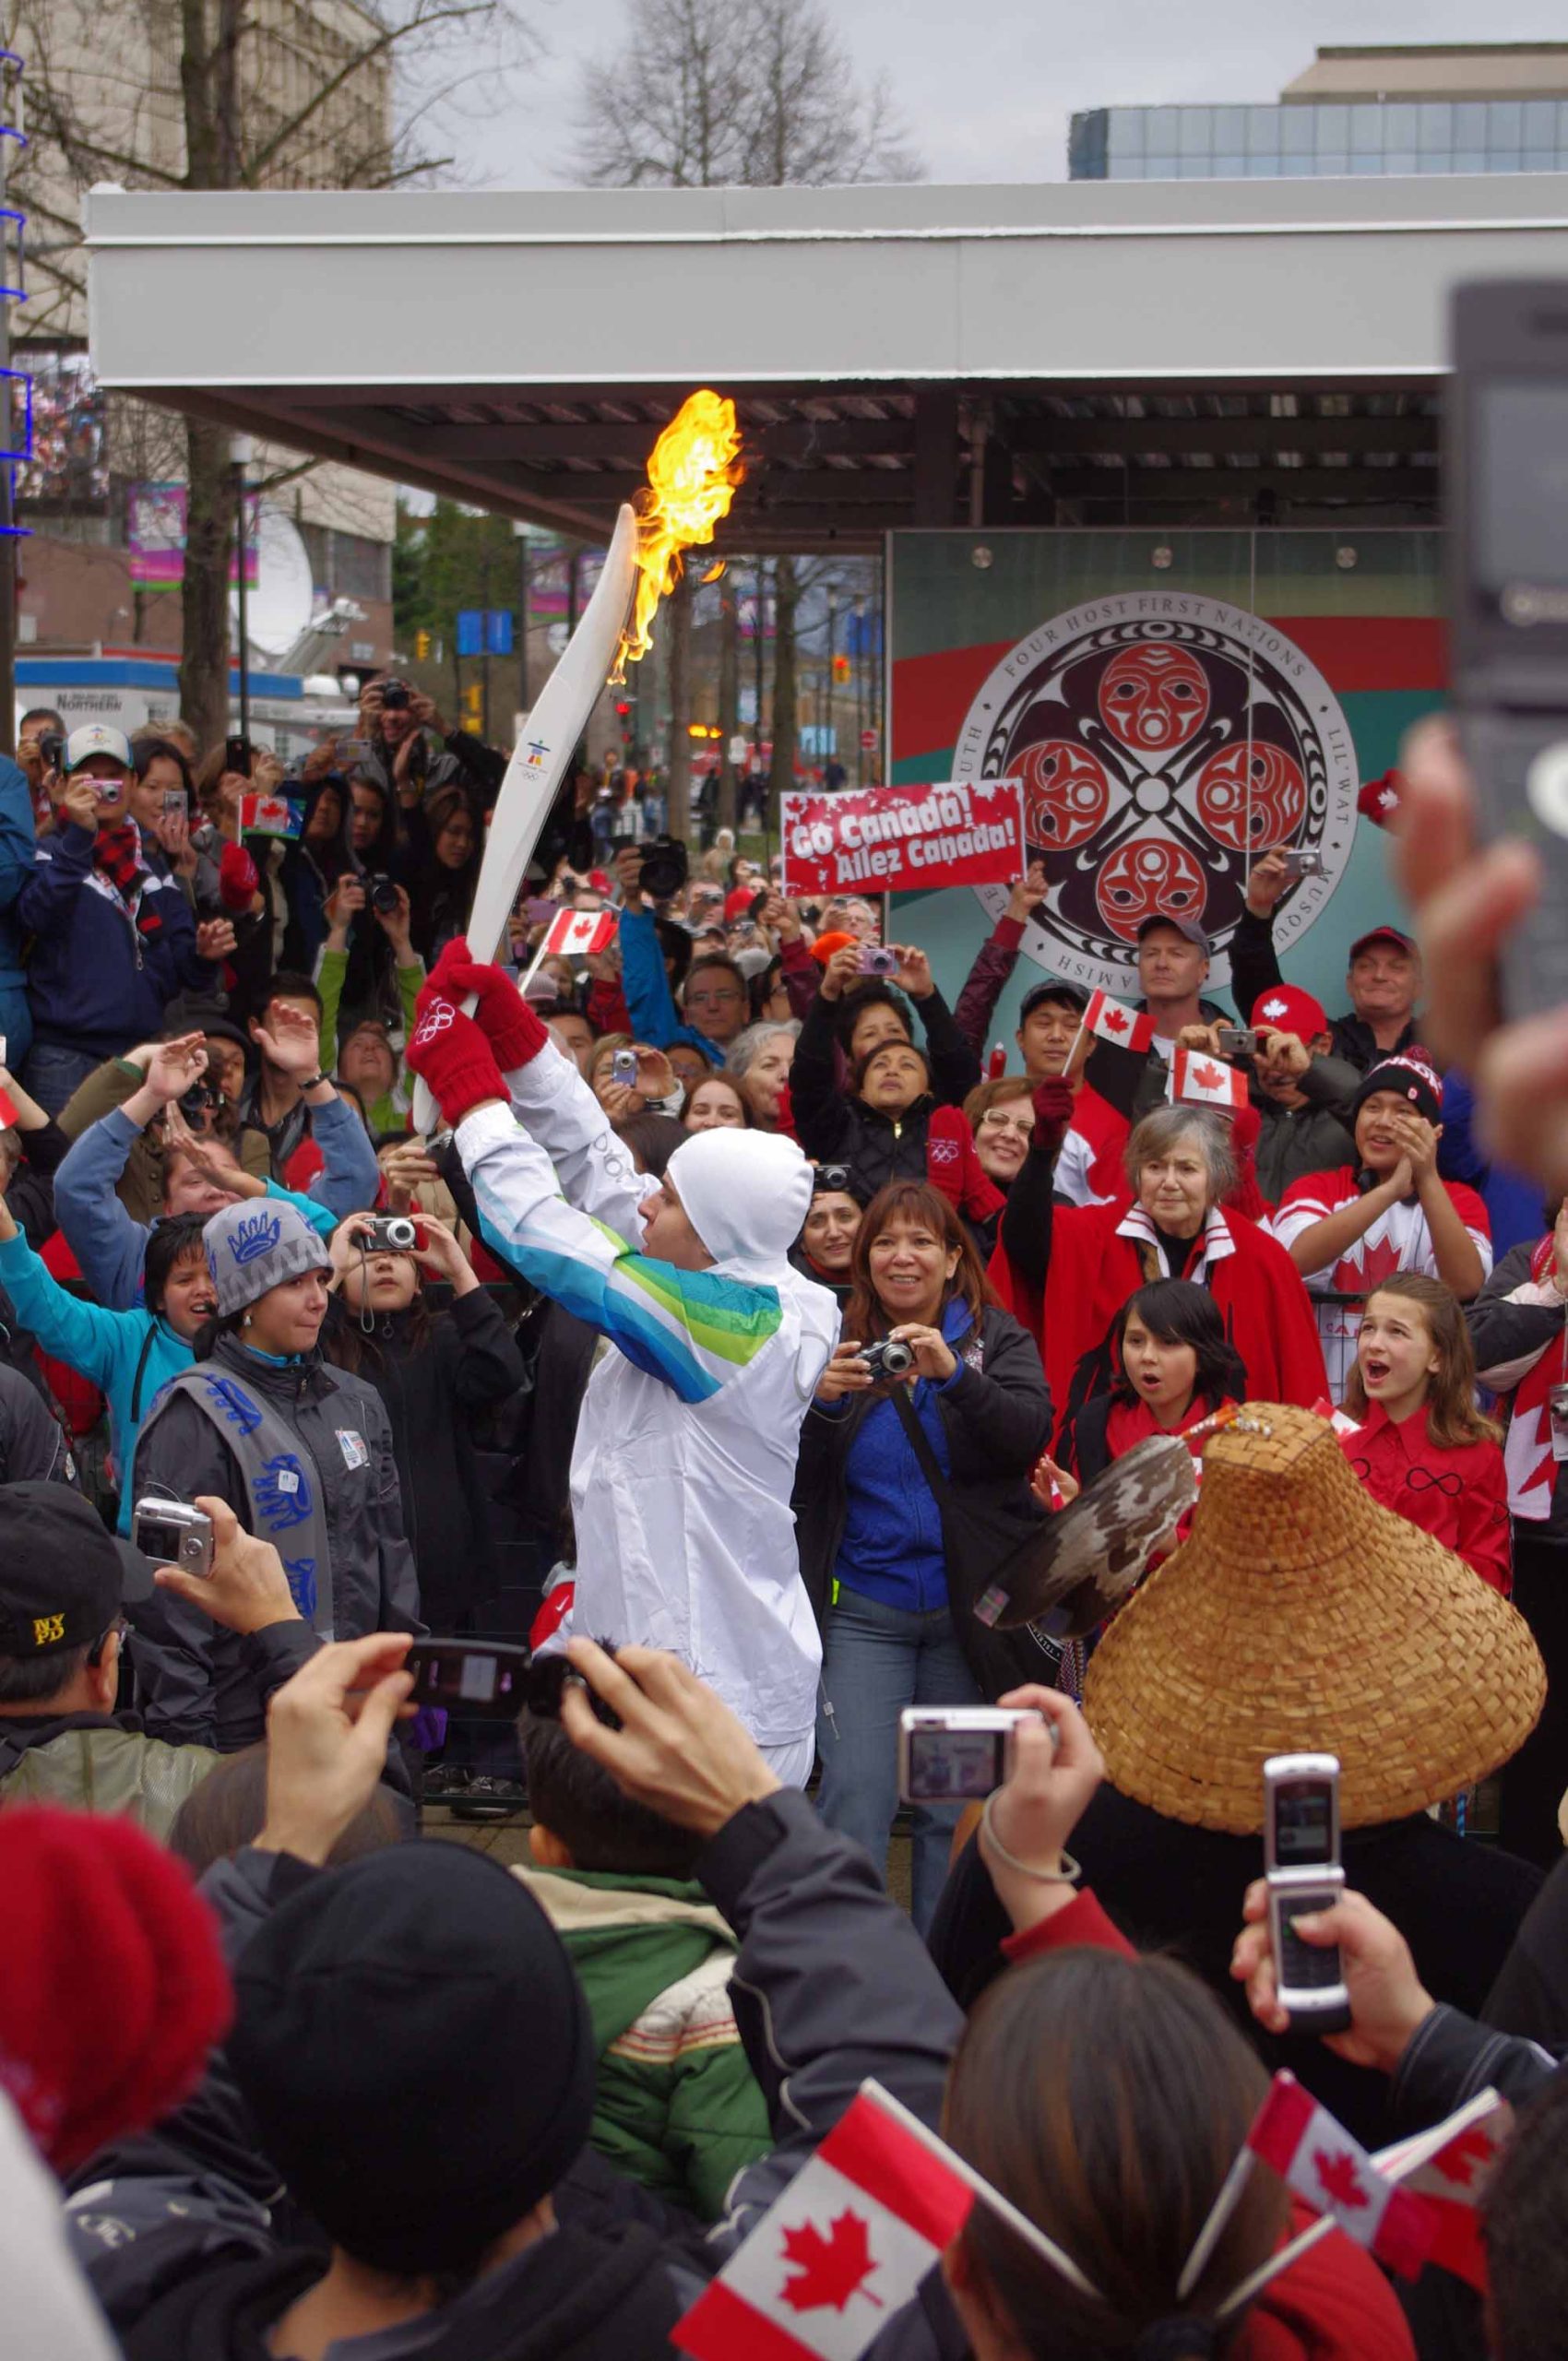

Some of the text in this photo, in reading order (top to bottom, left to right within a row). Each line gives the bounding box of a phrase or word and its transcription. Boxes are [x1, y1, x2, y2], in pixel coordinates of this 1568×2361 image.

[1004, 597, 1306, 679] FOUR HOST FIRST NATIONS
[1327, 729, 1352, 825] LIL'WAT
[836, 817, 1016, 885] Allez Canada!
[838, 786, 975, 848] Canada!
[1275, 866, 1335, 942] MUSQU
[1057, 954, 1134, 991] AMISH
